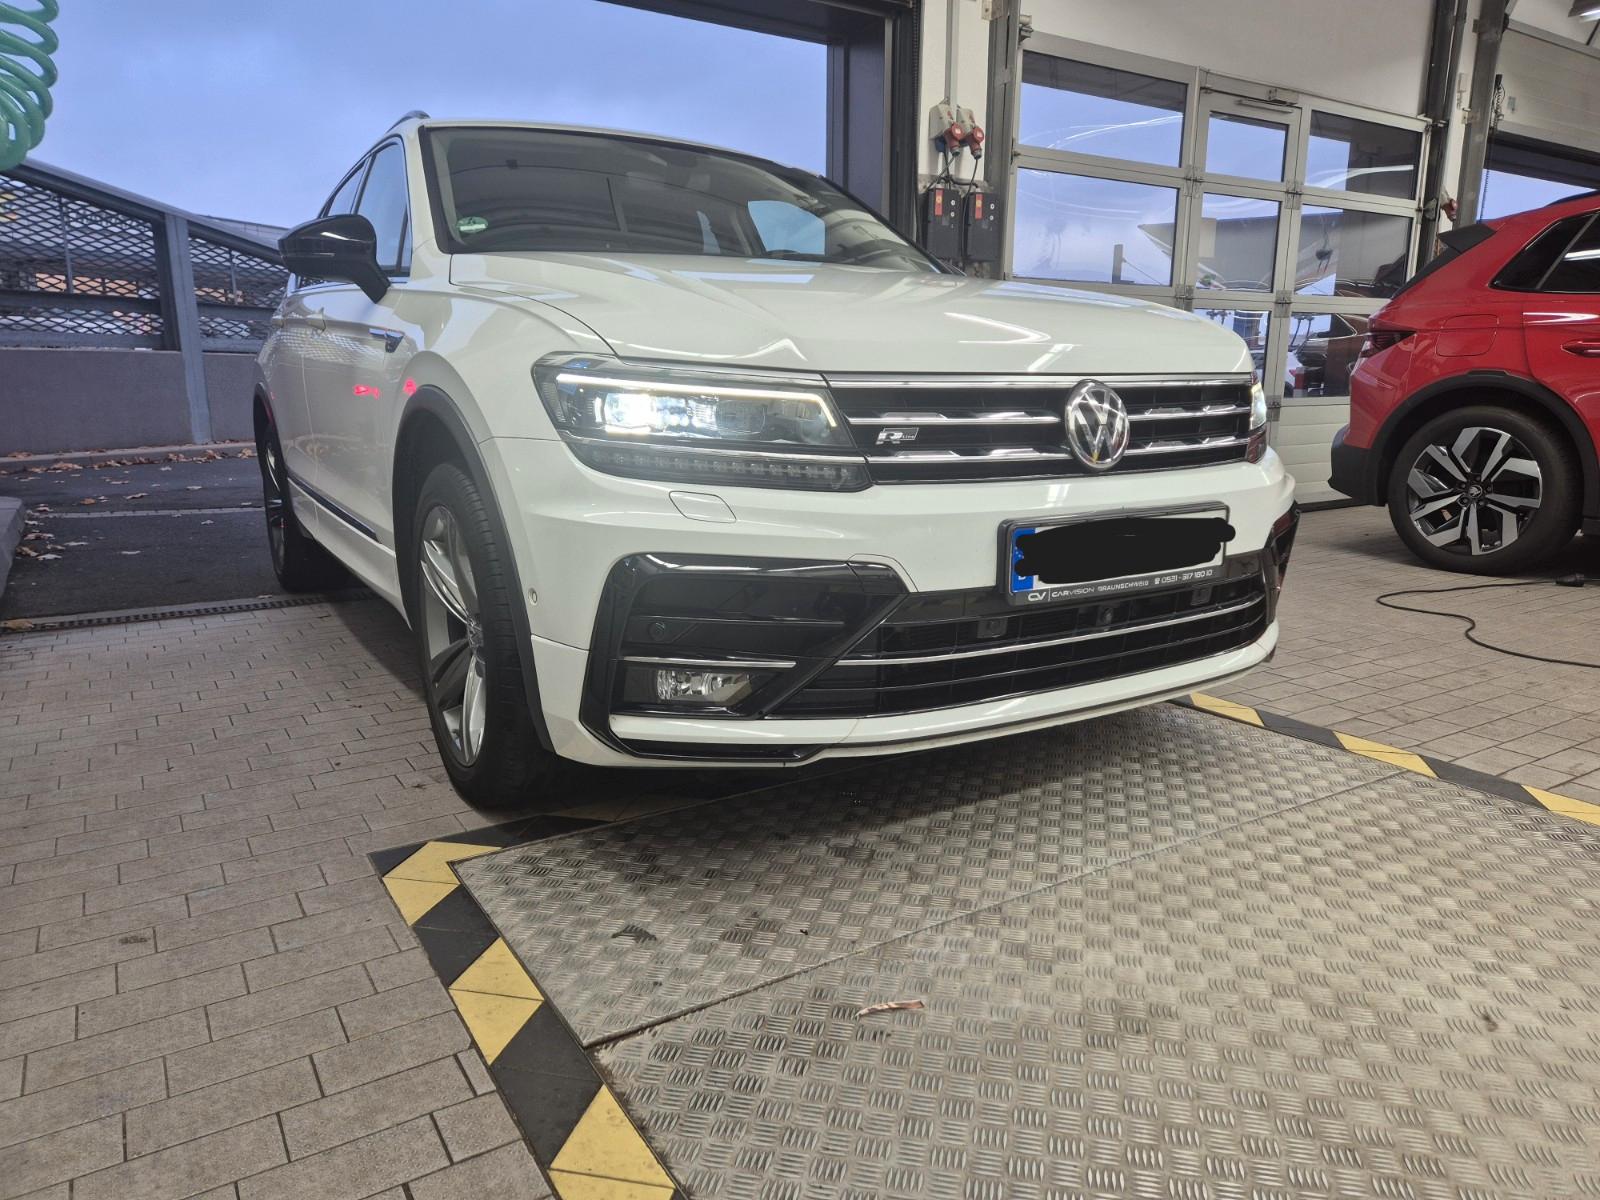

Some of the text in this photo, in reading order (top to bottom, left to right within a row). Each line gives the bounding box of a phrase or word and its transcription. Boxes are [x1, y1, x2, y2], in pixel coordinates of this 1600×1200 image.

[875, 431, 903, 445] R
[1051, 587, 1095, 598] CARVISION
[1097, 580, 1149, 592] BRAUNSCHWEIG
[1161, 574, 1178, 584] 0531
